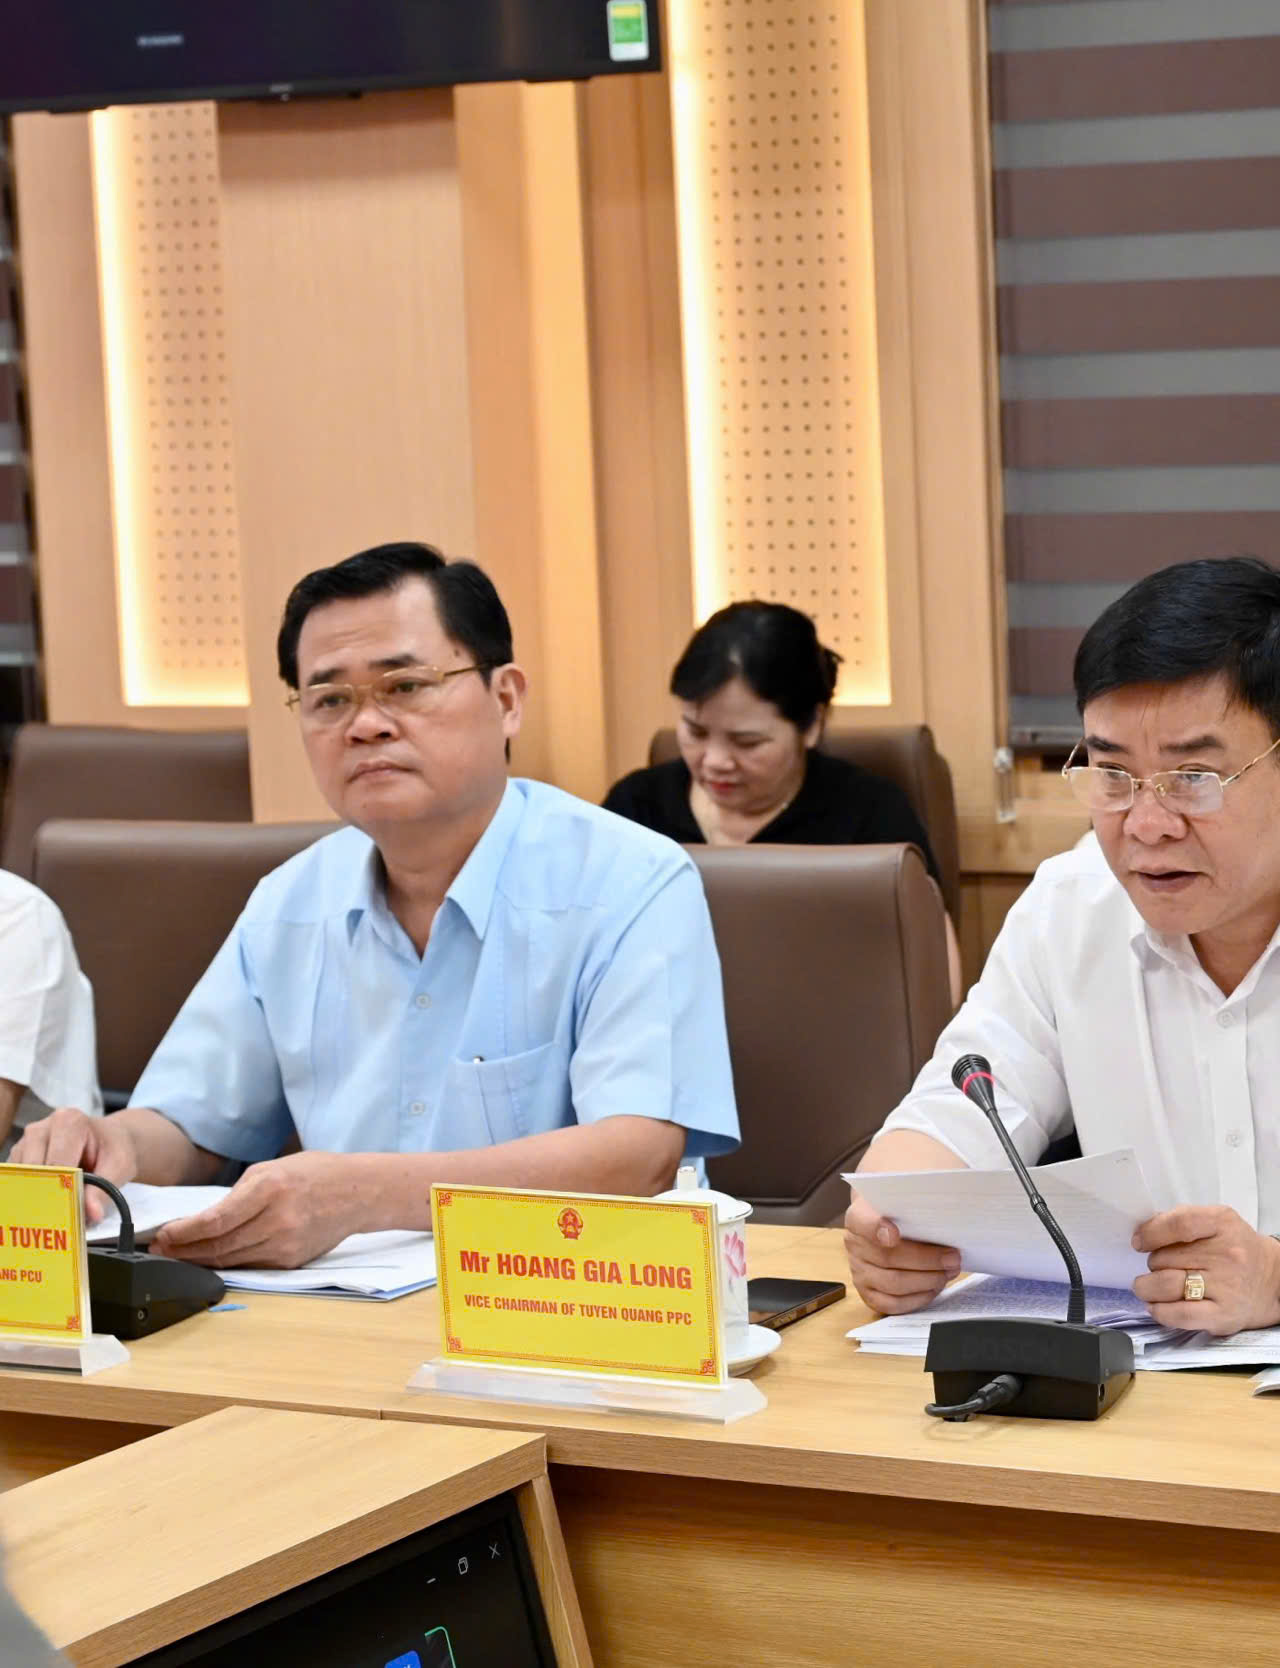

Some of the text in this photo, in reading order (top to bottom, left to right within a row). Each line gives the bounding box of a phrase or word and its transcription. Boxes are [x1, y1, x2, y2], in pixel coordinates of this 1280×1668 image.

[9, 1226, 68, 1251] TUYEN
[20, 1269, 42, 1283] PCU
[459, 1250, 692, 1290] Mr HOANG GIA LONG
[464, 1294, 692, 1326] VICE CHAIRMAN OF TUYEN QUANG PPC
